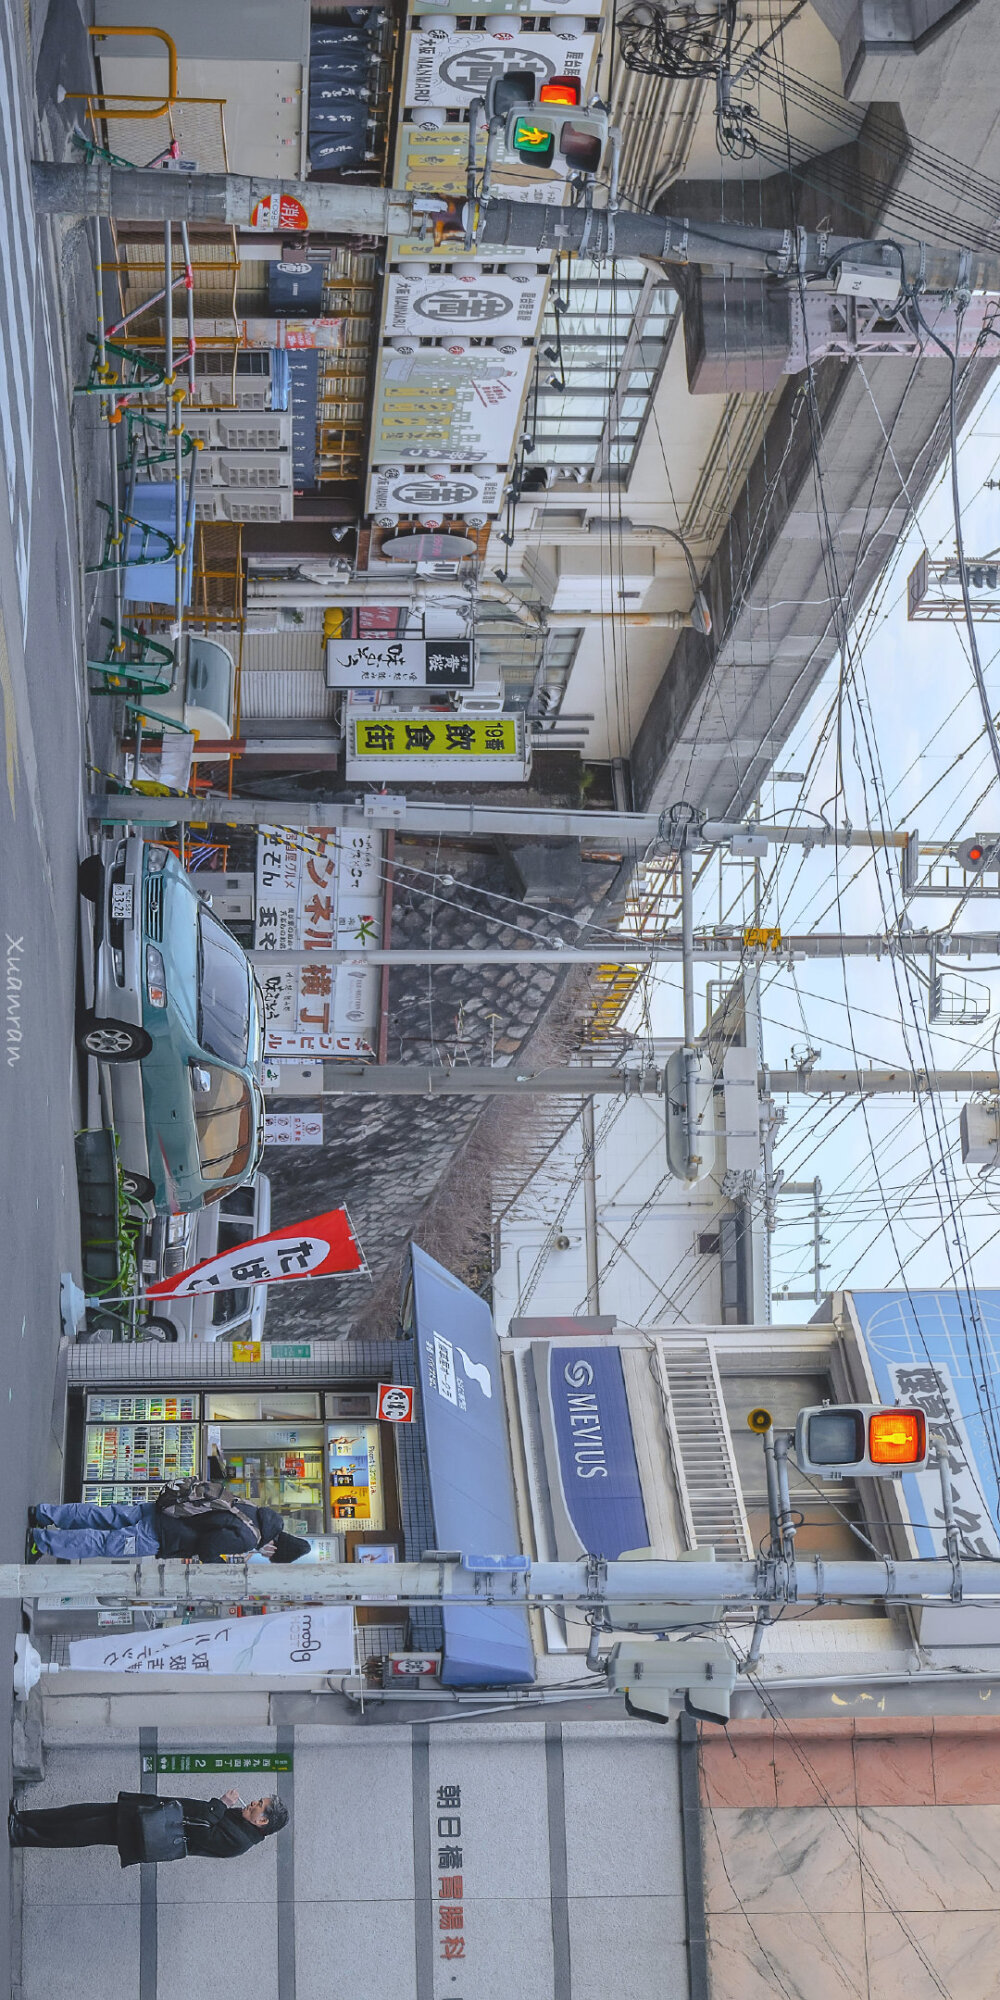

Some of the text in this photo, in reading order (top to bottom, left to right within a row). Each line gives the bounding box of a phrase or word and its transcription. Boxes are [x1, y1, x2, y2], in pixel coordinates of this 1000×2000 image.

[414, 38, 437, 102] 大阪 MANMARU
[280, 202, 299, 228] 消火
[428, 654, 460, 674] 黄桜
[364, 724, 476, 750] 飲食街
[485, 722, 504, 750] 19番
[262, 832, 282, 886] せぞん
[114, 892, 124, 916] 33-28
[300, 826, 336, 1034] トンネル横丁
[186, 1240, 314, 1291] たばこ
[386, 1392, 406, 1418] たばこ
[566, 1393, 608, 1479] MEVIUS
[195, 1759, 206, 1768] 2
[215, 1759, 271, 1767] 西九条四丁目
[436, 1785, 466, 2000] 朝日橋胃腸科・
